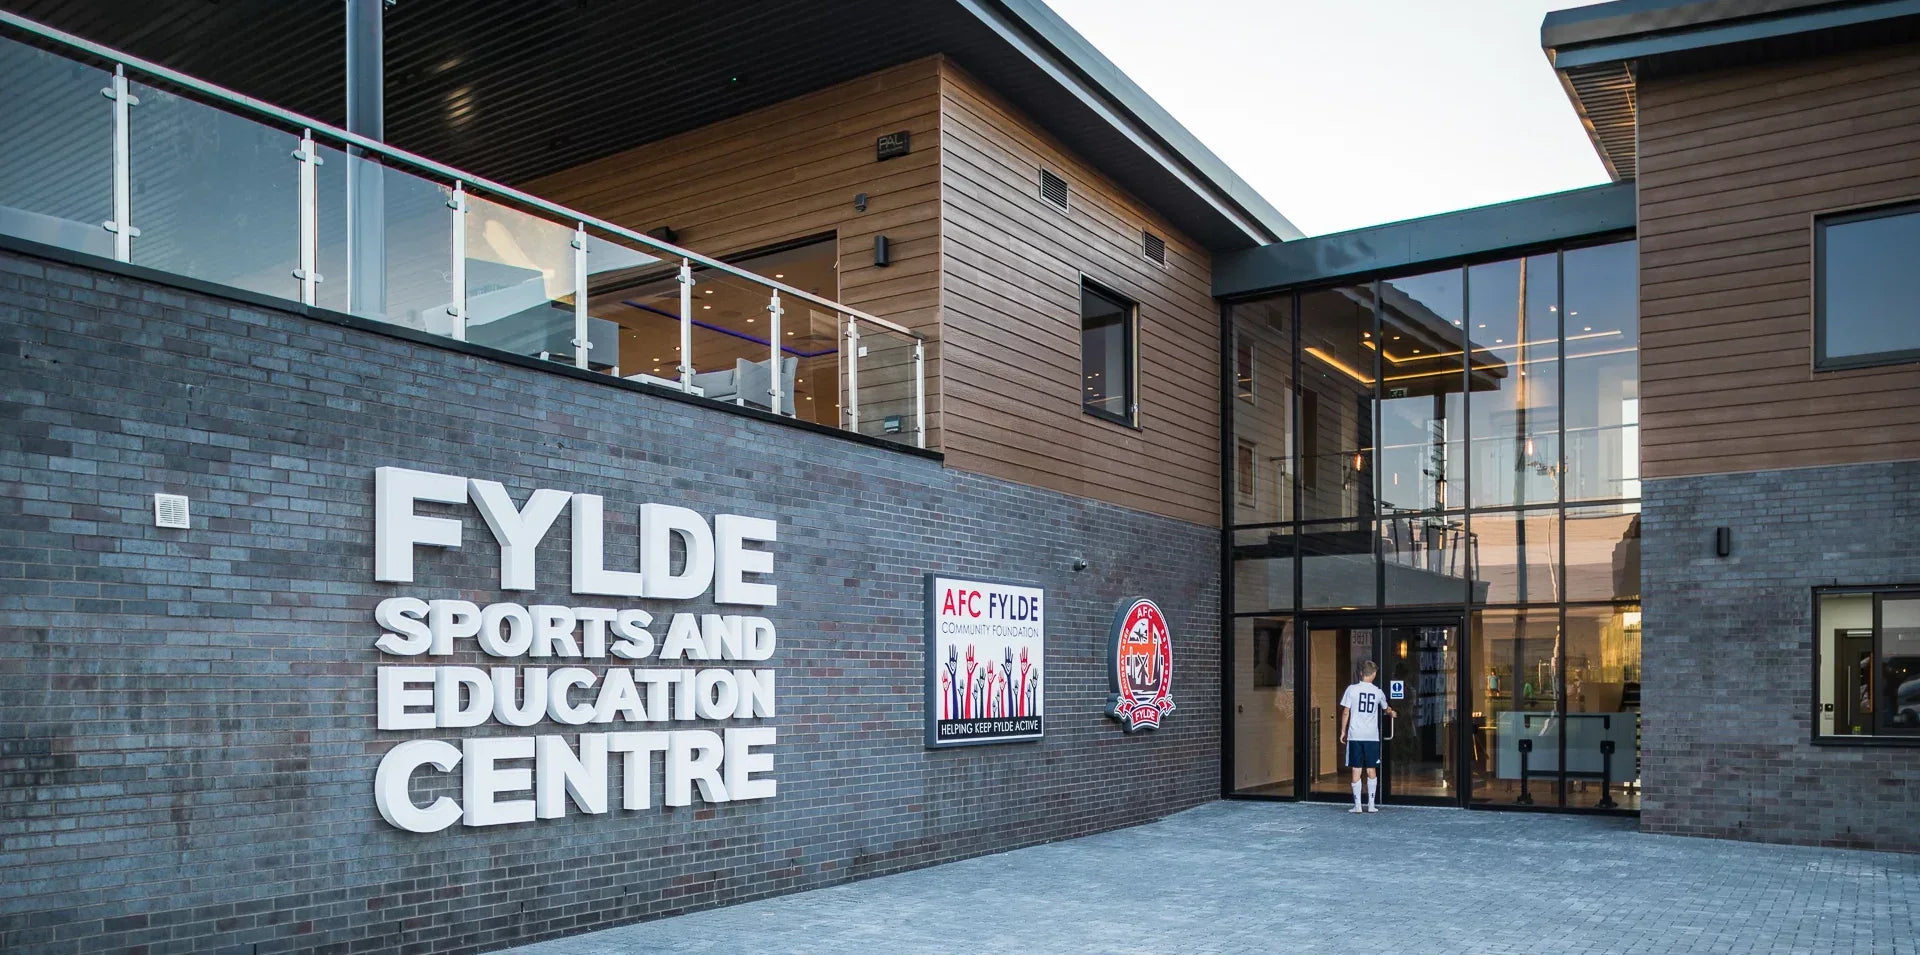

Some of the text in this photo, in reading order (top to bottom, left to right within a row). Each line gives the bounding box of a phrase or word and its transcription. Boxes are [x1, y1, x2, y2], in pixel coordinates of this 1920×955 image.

[879, 135, 904, 150] PAL
[375, 466, 777, 606] FYLDE
[942, 588, 1038, 622] AFC FYLDE
[1136, 606, 1154, 619] AFC
[374, 597, 776, 660] SPORTS AND
[941, 621, 1039, 638] COMMUNITY FOUNDATION
[377, 666, 776, 730] EDUCATION
[1358, 692, 1376, 713] 66
[1135, 707, 1156, 720] FYLDE
[941, 719, 1039, 736] HELPING KEEP FYLDE ACTIVE
[374, 727, 777, 833] CENTRE
